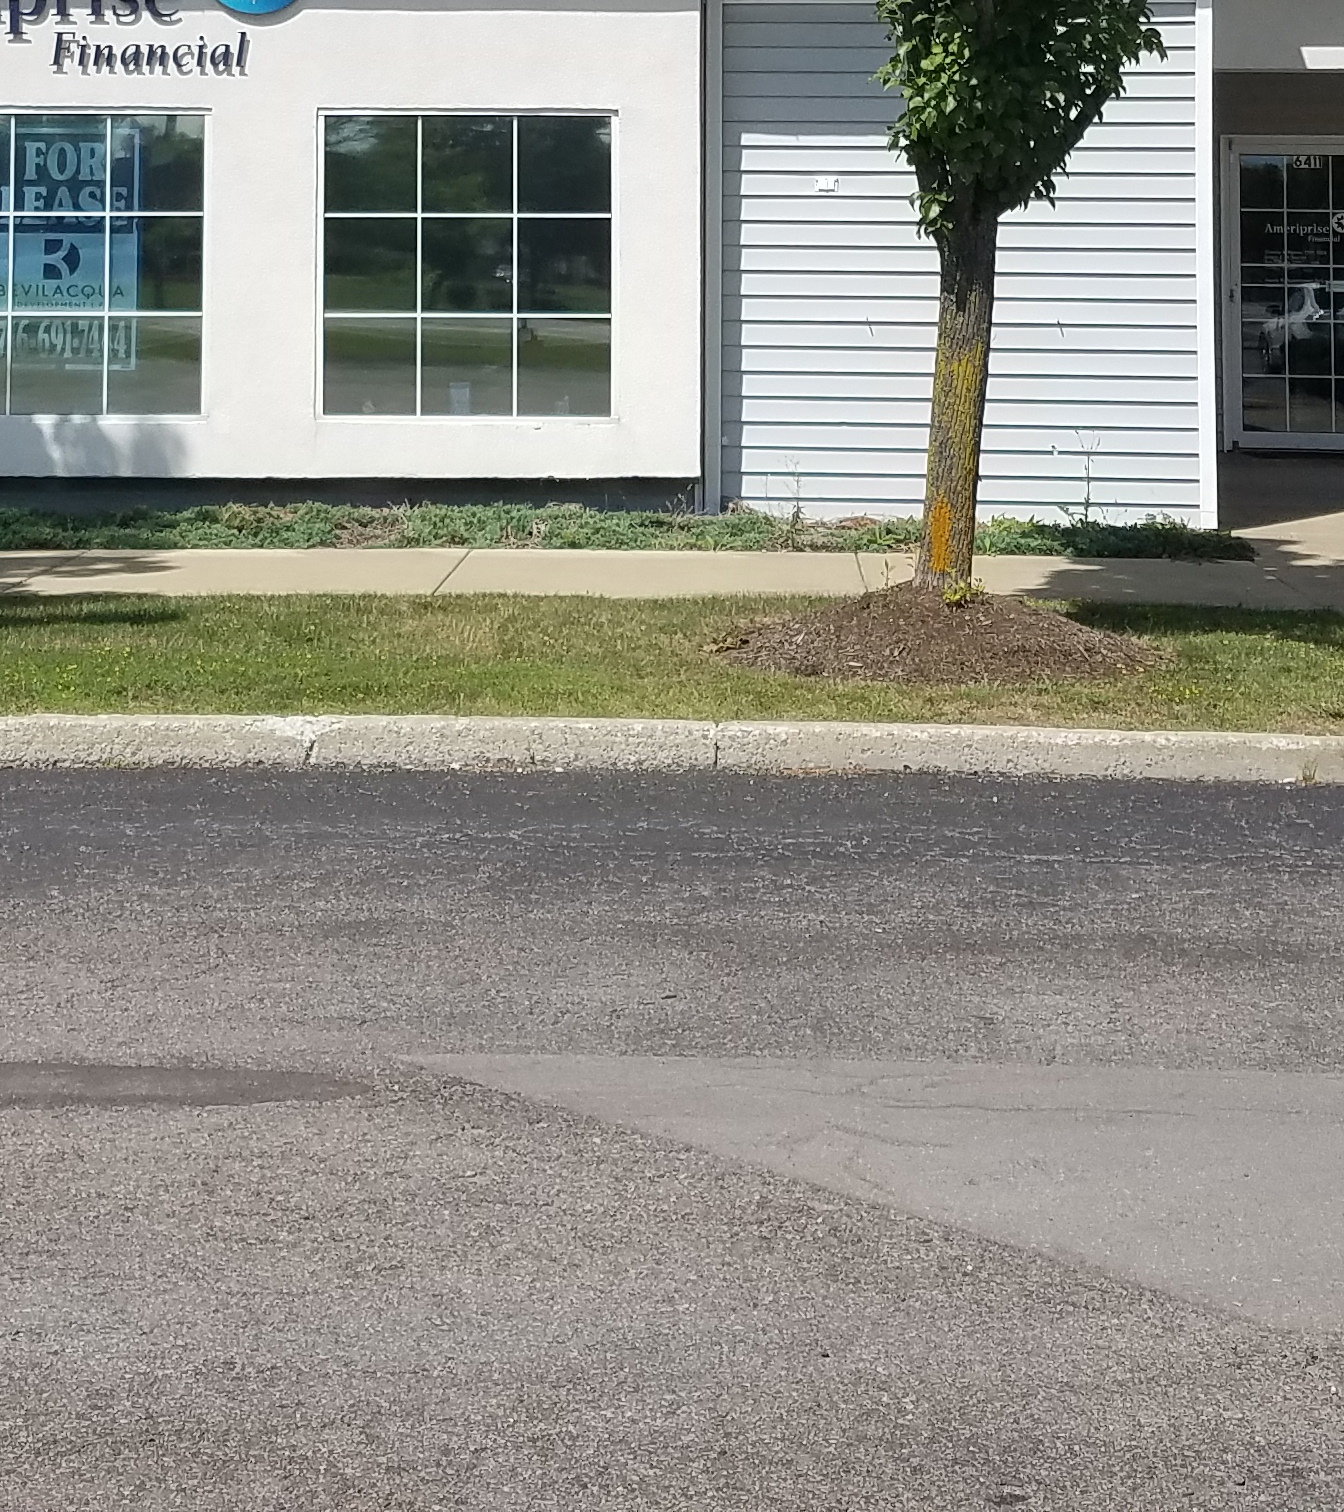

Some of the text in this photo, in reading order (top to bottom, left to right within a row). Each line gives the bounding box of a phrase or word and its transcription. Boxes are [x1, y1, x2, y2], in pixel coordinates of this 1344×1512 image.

[51, 31, 249, 70] Financial
[23, 141, 106, 181] FOR
[1294, 155, 1322, 168] 6411
[0, 185, 128, 226] LEASE
[1264, 223, 1330, 236] Ameriprise
